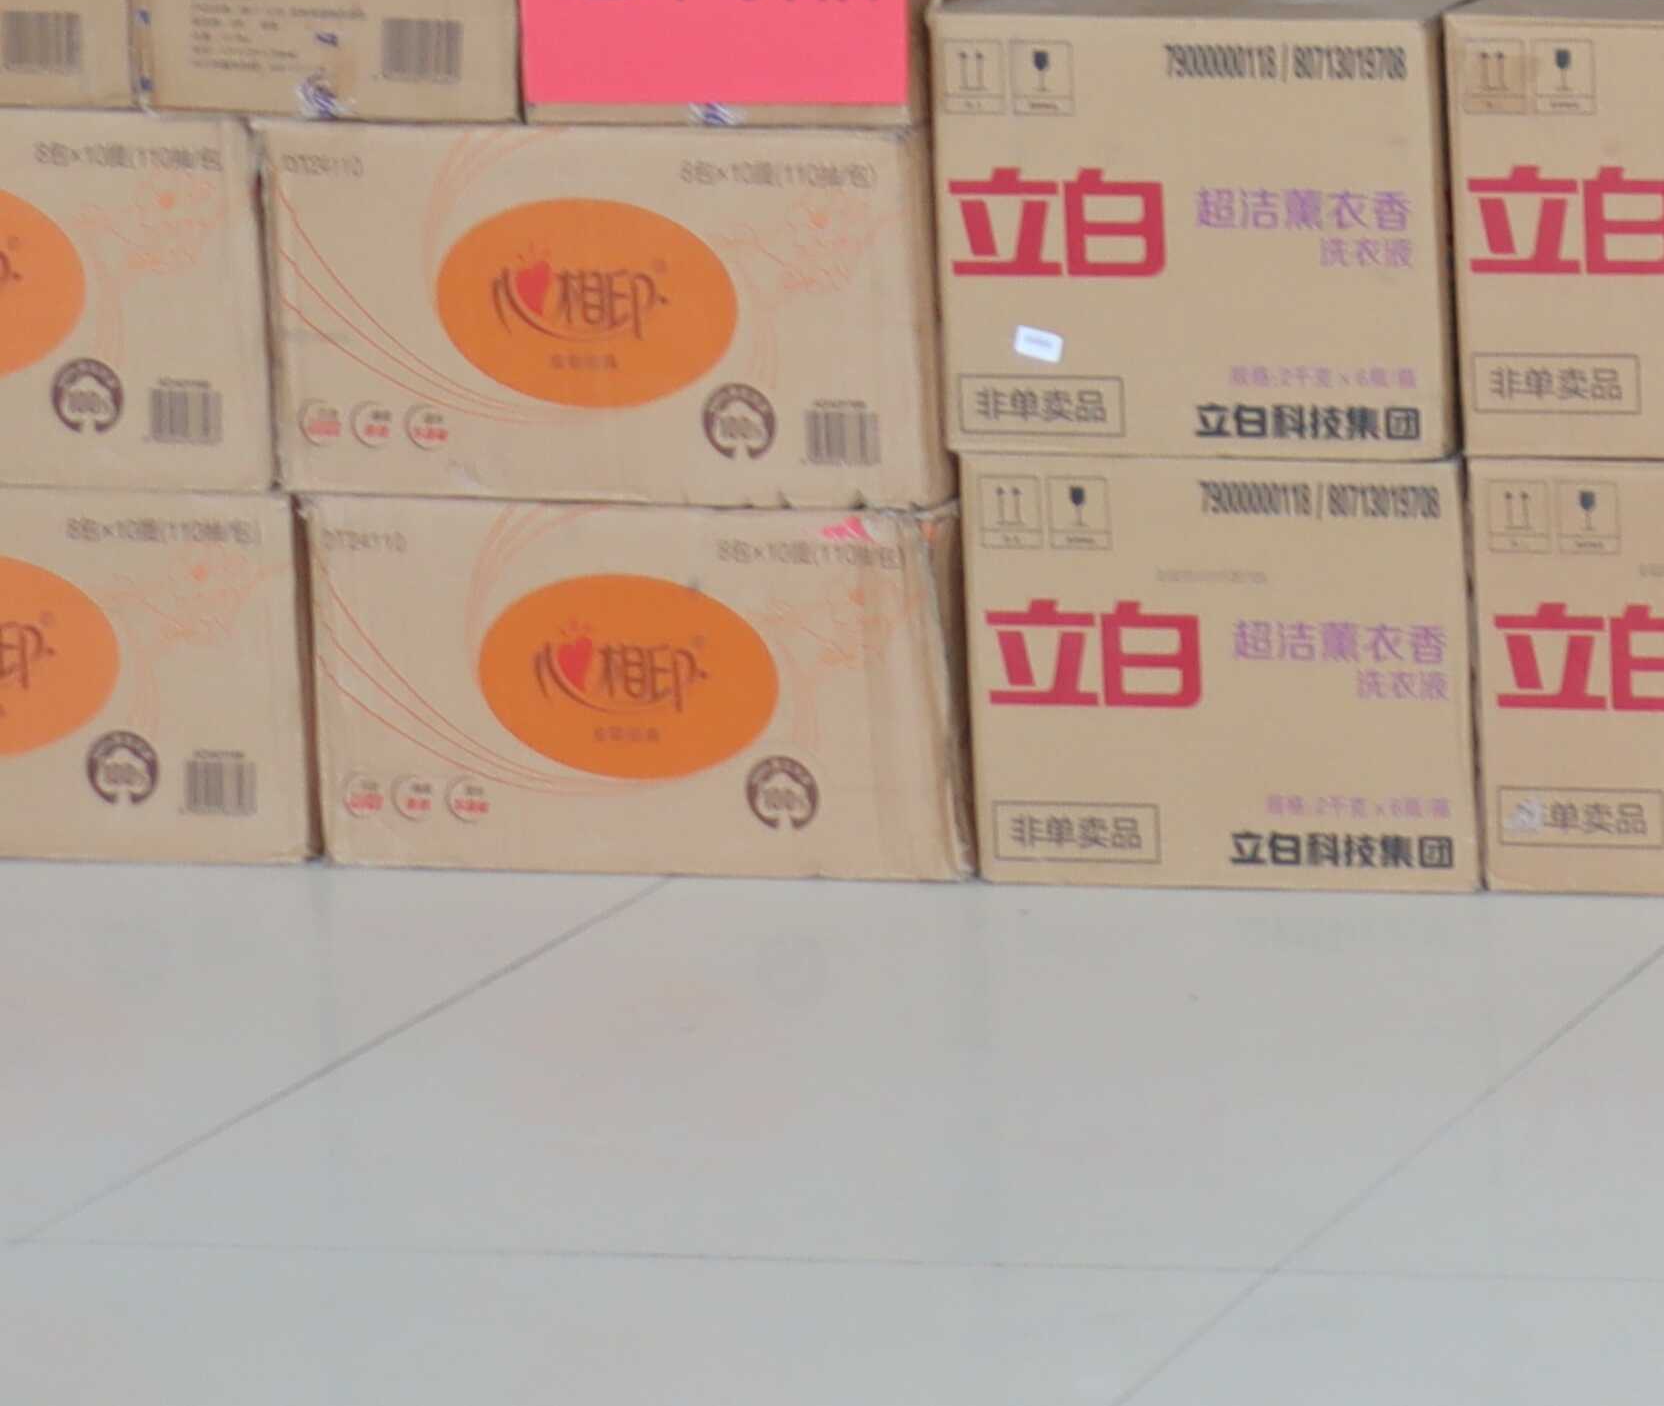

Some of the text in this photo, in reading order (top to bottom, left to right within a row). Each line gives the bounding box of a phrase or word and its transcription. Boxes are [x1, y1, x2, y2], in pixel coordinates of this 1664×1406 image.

[949, 167, 1166, 278] 立白
[1197, 188, 1409, 231] 超洁薰衣香
[1320, 236, 1412, 268] 洗衣液
[1491, 367, 1622, 401] 非单卖品
[977, 388, 1106, 423] 非单卖品
[1196, 403, 1420, 441] 立白科技集团
[985, 599, 1202, 709] 立白
[1234, 620, 1445, 665] 超洁薰衣香
[1357, 669, 1448, 700] 洗衣液
[1011, 814, 1142, 850] 非单卖品
[1231, 831, 1454, 869] 立白科技集团
